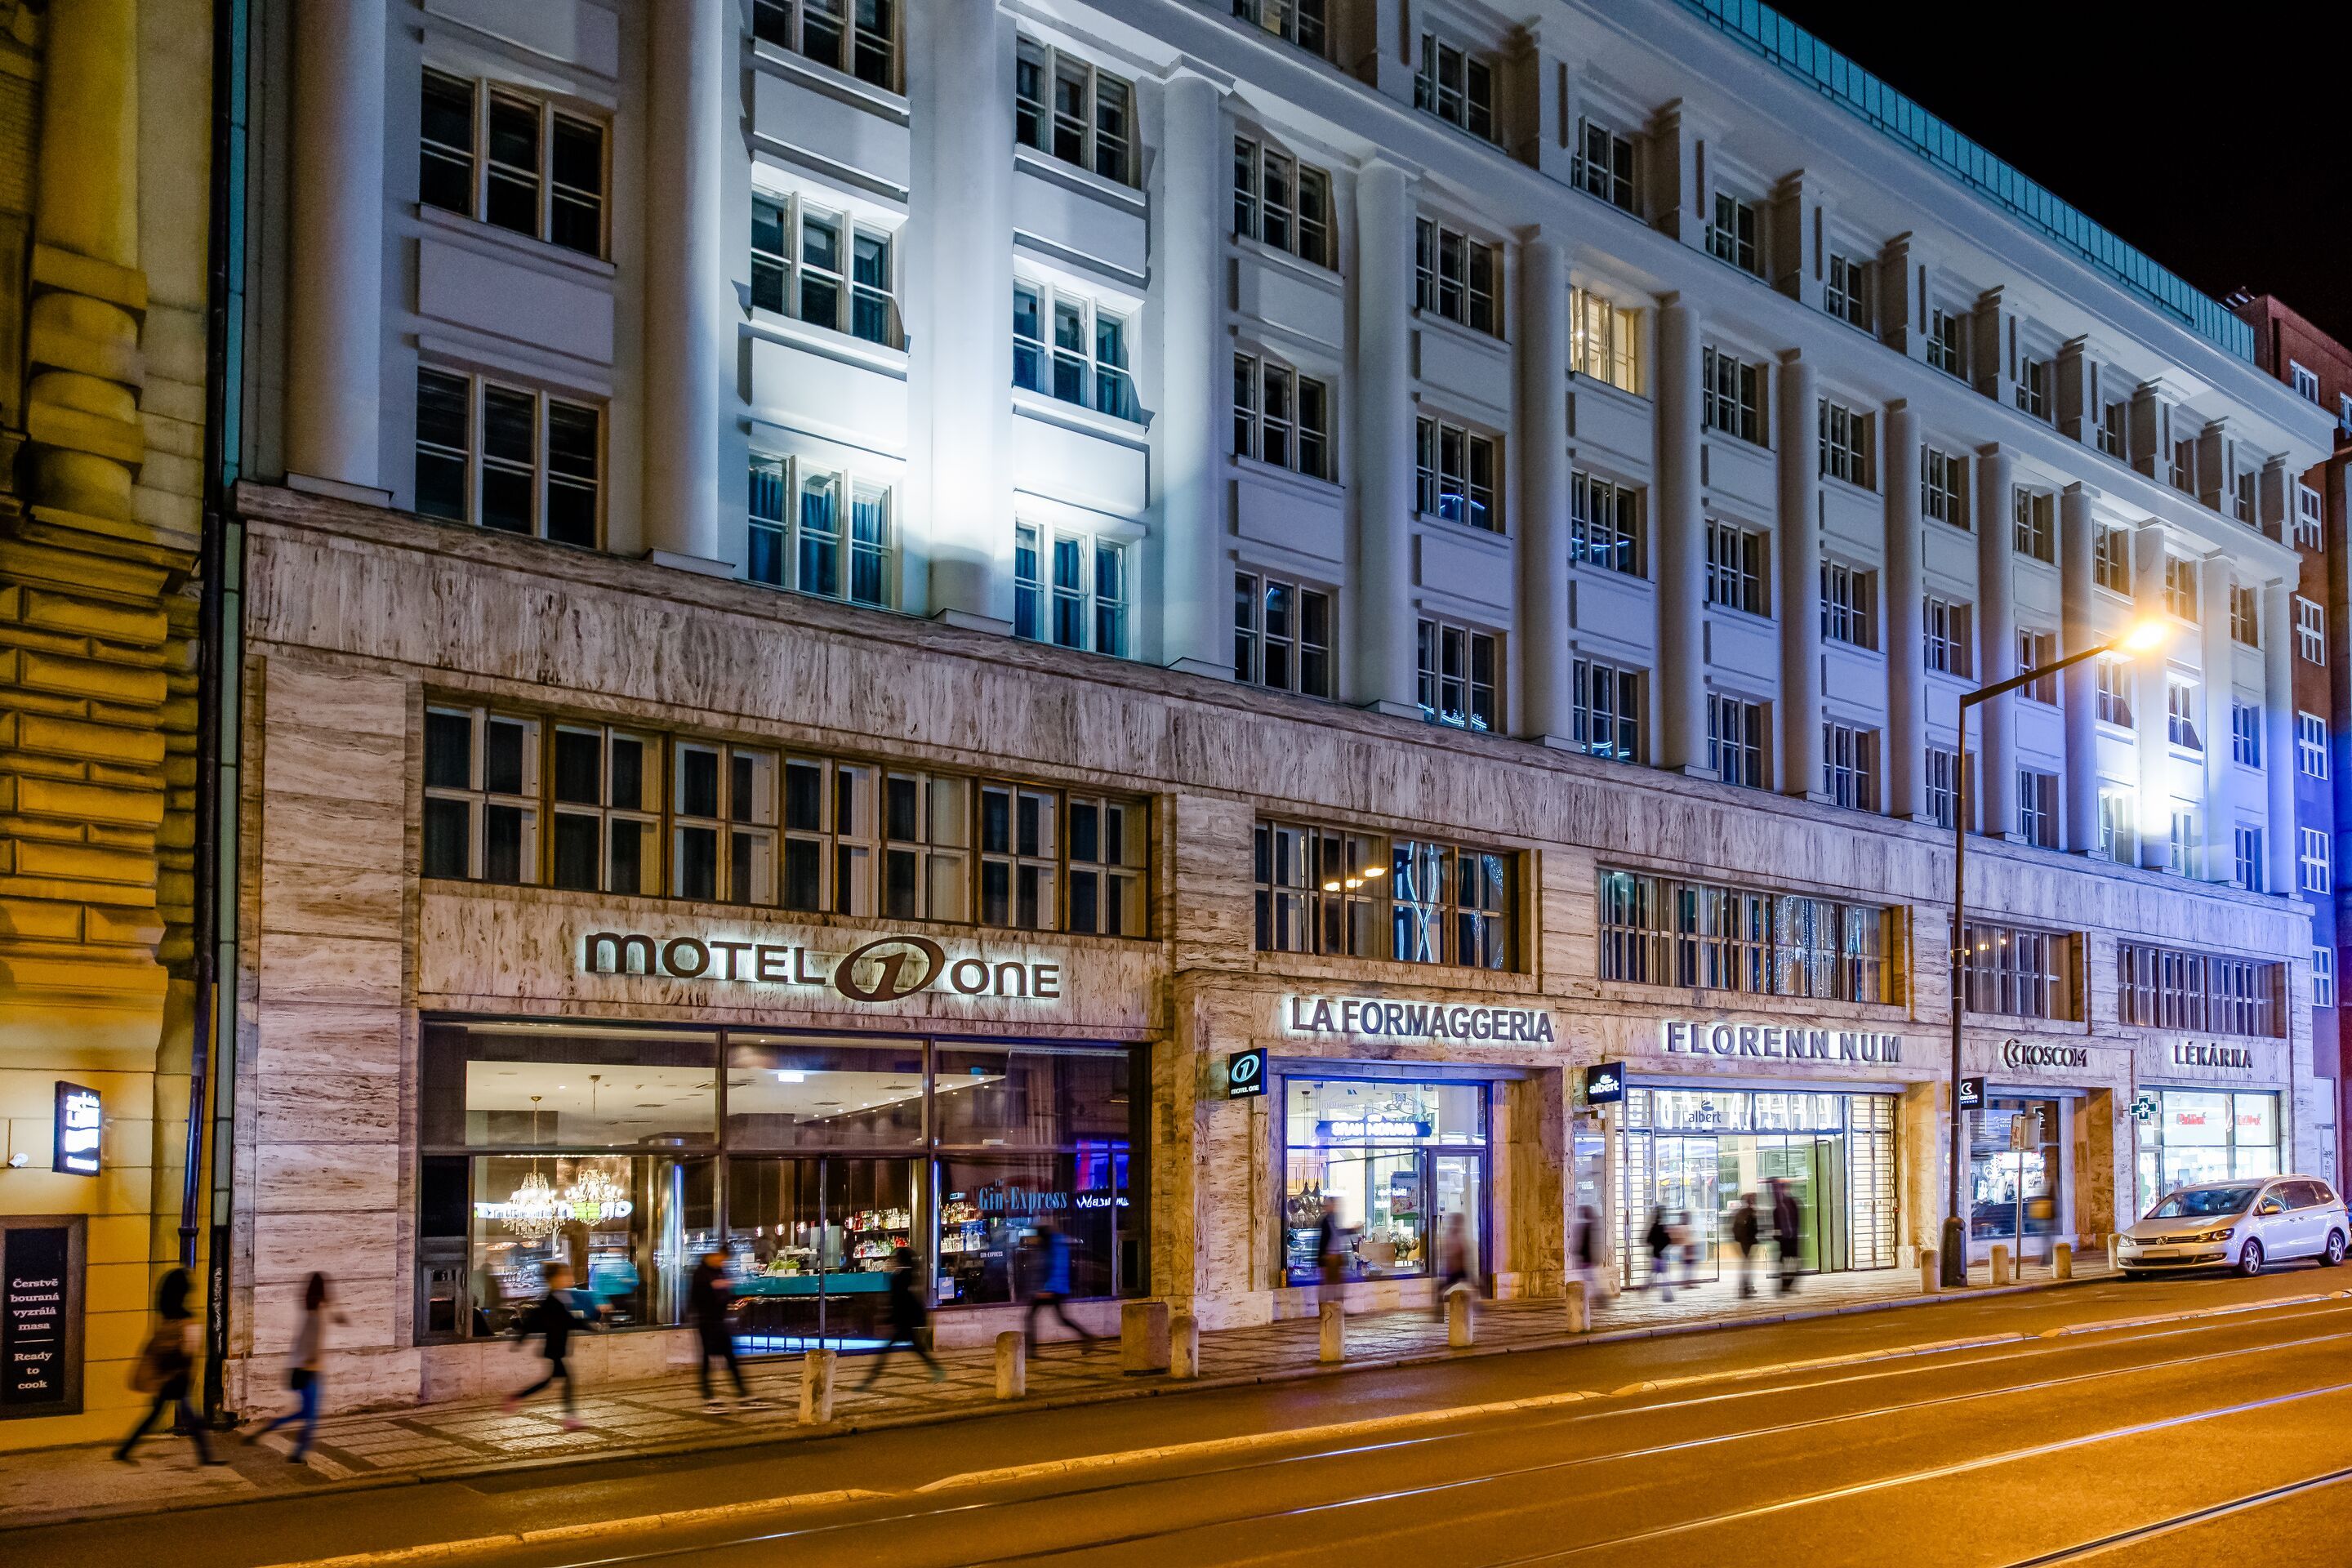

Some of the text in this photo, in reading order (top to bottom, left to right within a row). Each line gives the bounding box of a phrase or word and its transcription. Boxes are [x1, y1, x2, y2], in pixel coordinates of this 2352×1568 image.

[1292, 996, 1555, 1043] LA FORMAGGERIA
[2021, 1045, 2088, 1067] KOSCOM
[2174, 1040, 2254, 1068] LÉKÁRNA
[1588, 1080, 1619, 1094] albert
[1688, 1110, 1722, 1124] albert
[978, 1187, 1067, 1215] Gin-Express
[10, 1293, 60, 1303] bouraná
[13, 1307, 57, 1318] vyzrálá
[18, 1322, 51, 1331] masa
[14, 1352, 53, 1361] Ready
[26, 1366, 40, 1375] to
[18, 1380, 47, 1389] cook
